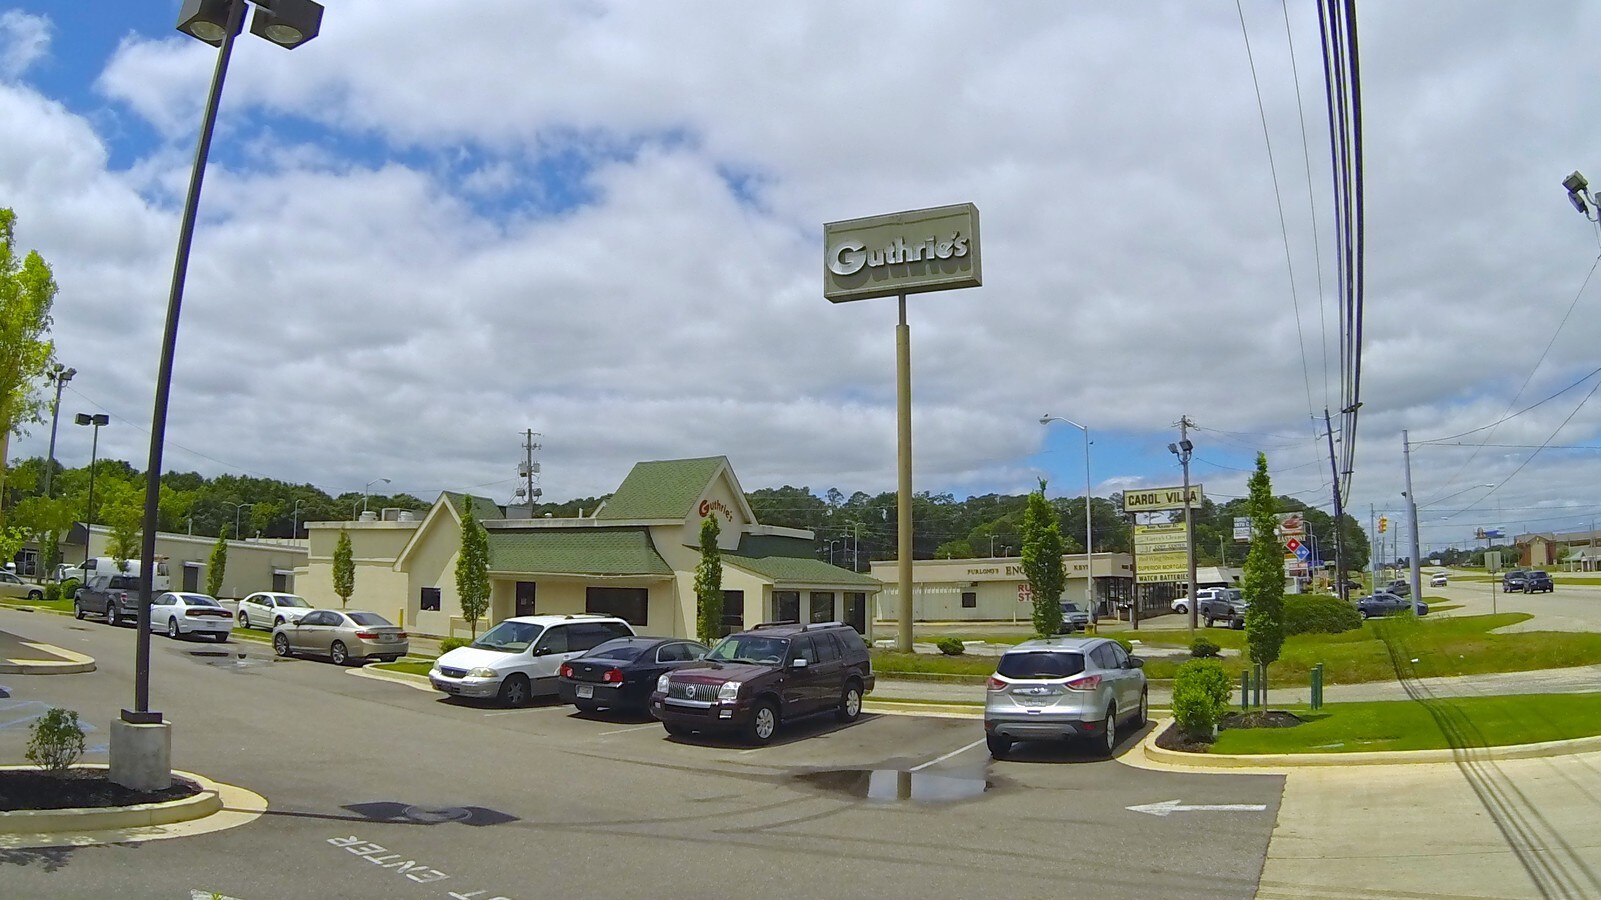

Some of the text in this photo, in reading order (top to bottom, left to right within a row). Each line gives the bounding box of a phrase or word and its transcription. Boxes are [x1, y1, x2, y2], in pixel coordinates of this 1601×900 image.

[827, 231, 969, 276] Guthrie's
[1128, 491, 1197, 506] CAROL VILA
[327, 835, 451, 884] ENTER
